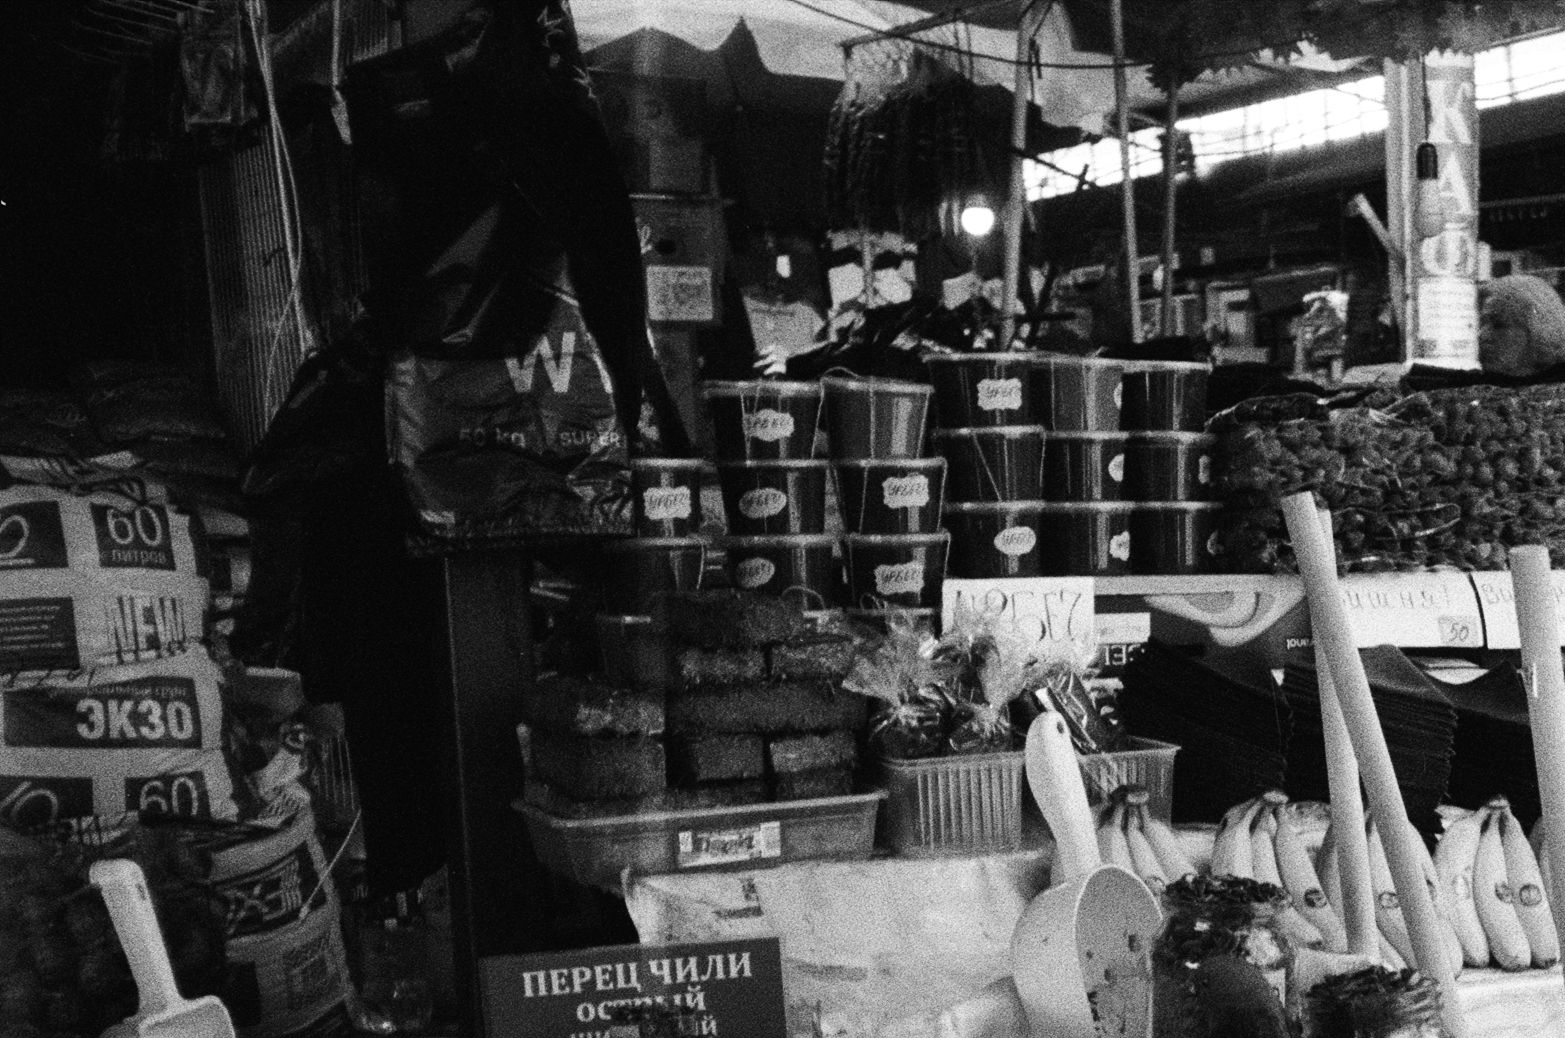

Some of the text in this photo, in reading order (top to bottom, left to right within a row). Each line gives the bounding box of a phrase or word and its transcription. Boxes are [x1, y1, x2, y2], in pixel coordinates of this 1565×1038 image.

[106, 506, 163, 547] 60
[1447, 621, 1470, 643] 50
[75, 697, 194, 740] ЭКЗО
[522, 951, 753, 998] ПЕРЕЦ ЧИЛИ
